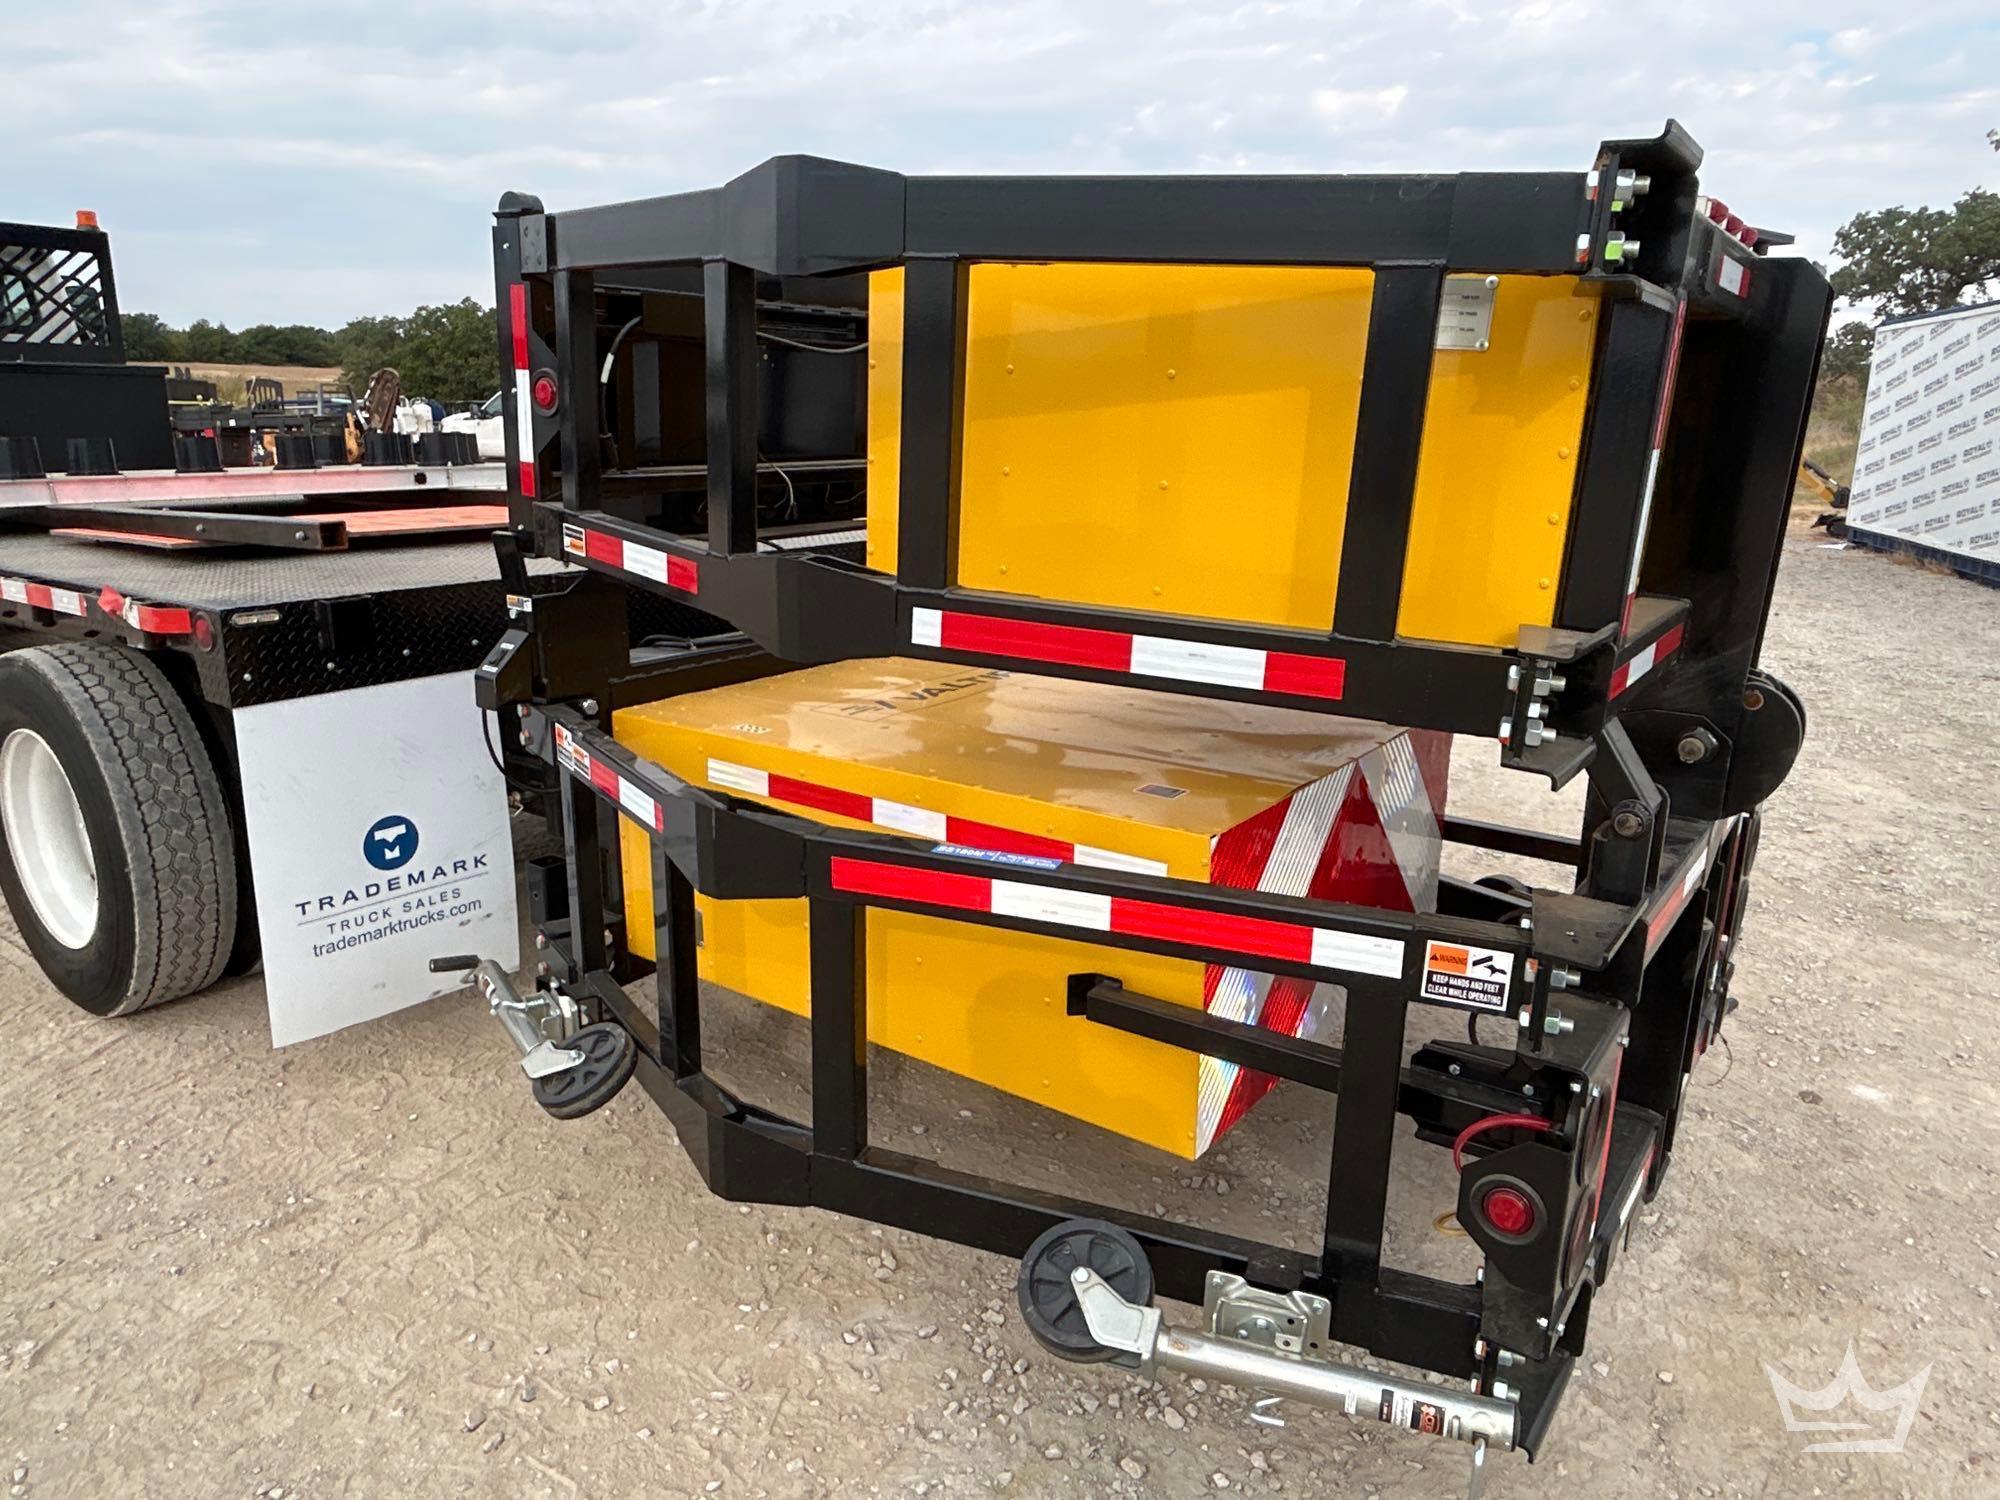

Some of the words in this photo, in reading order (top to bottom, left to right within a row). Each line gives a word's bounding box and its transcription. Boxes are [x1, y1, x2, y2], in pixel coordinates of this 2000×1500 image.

[295, 853, 488, 916] TRADEMARK
[312, 898, 482, 958] trademarktrucks.com
[326, 907, 393, 935] TRUCK
[402, 887, 462, 914] SALES
[1439, 953, 1468, 966] WARNING
[1427, 983, 1448, 994] CLEAR
[1448, 986, 1468, 999] WHILE
[1468, 990, 1502, 1005] OPERATING
[1432, 973, 1449, 985] KEEP
[1449, 976, 1470, 989] HANDS
[1470, 980, 1484, 991] AND
[1484, 982, 1500, 994] FEET
